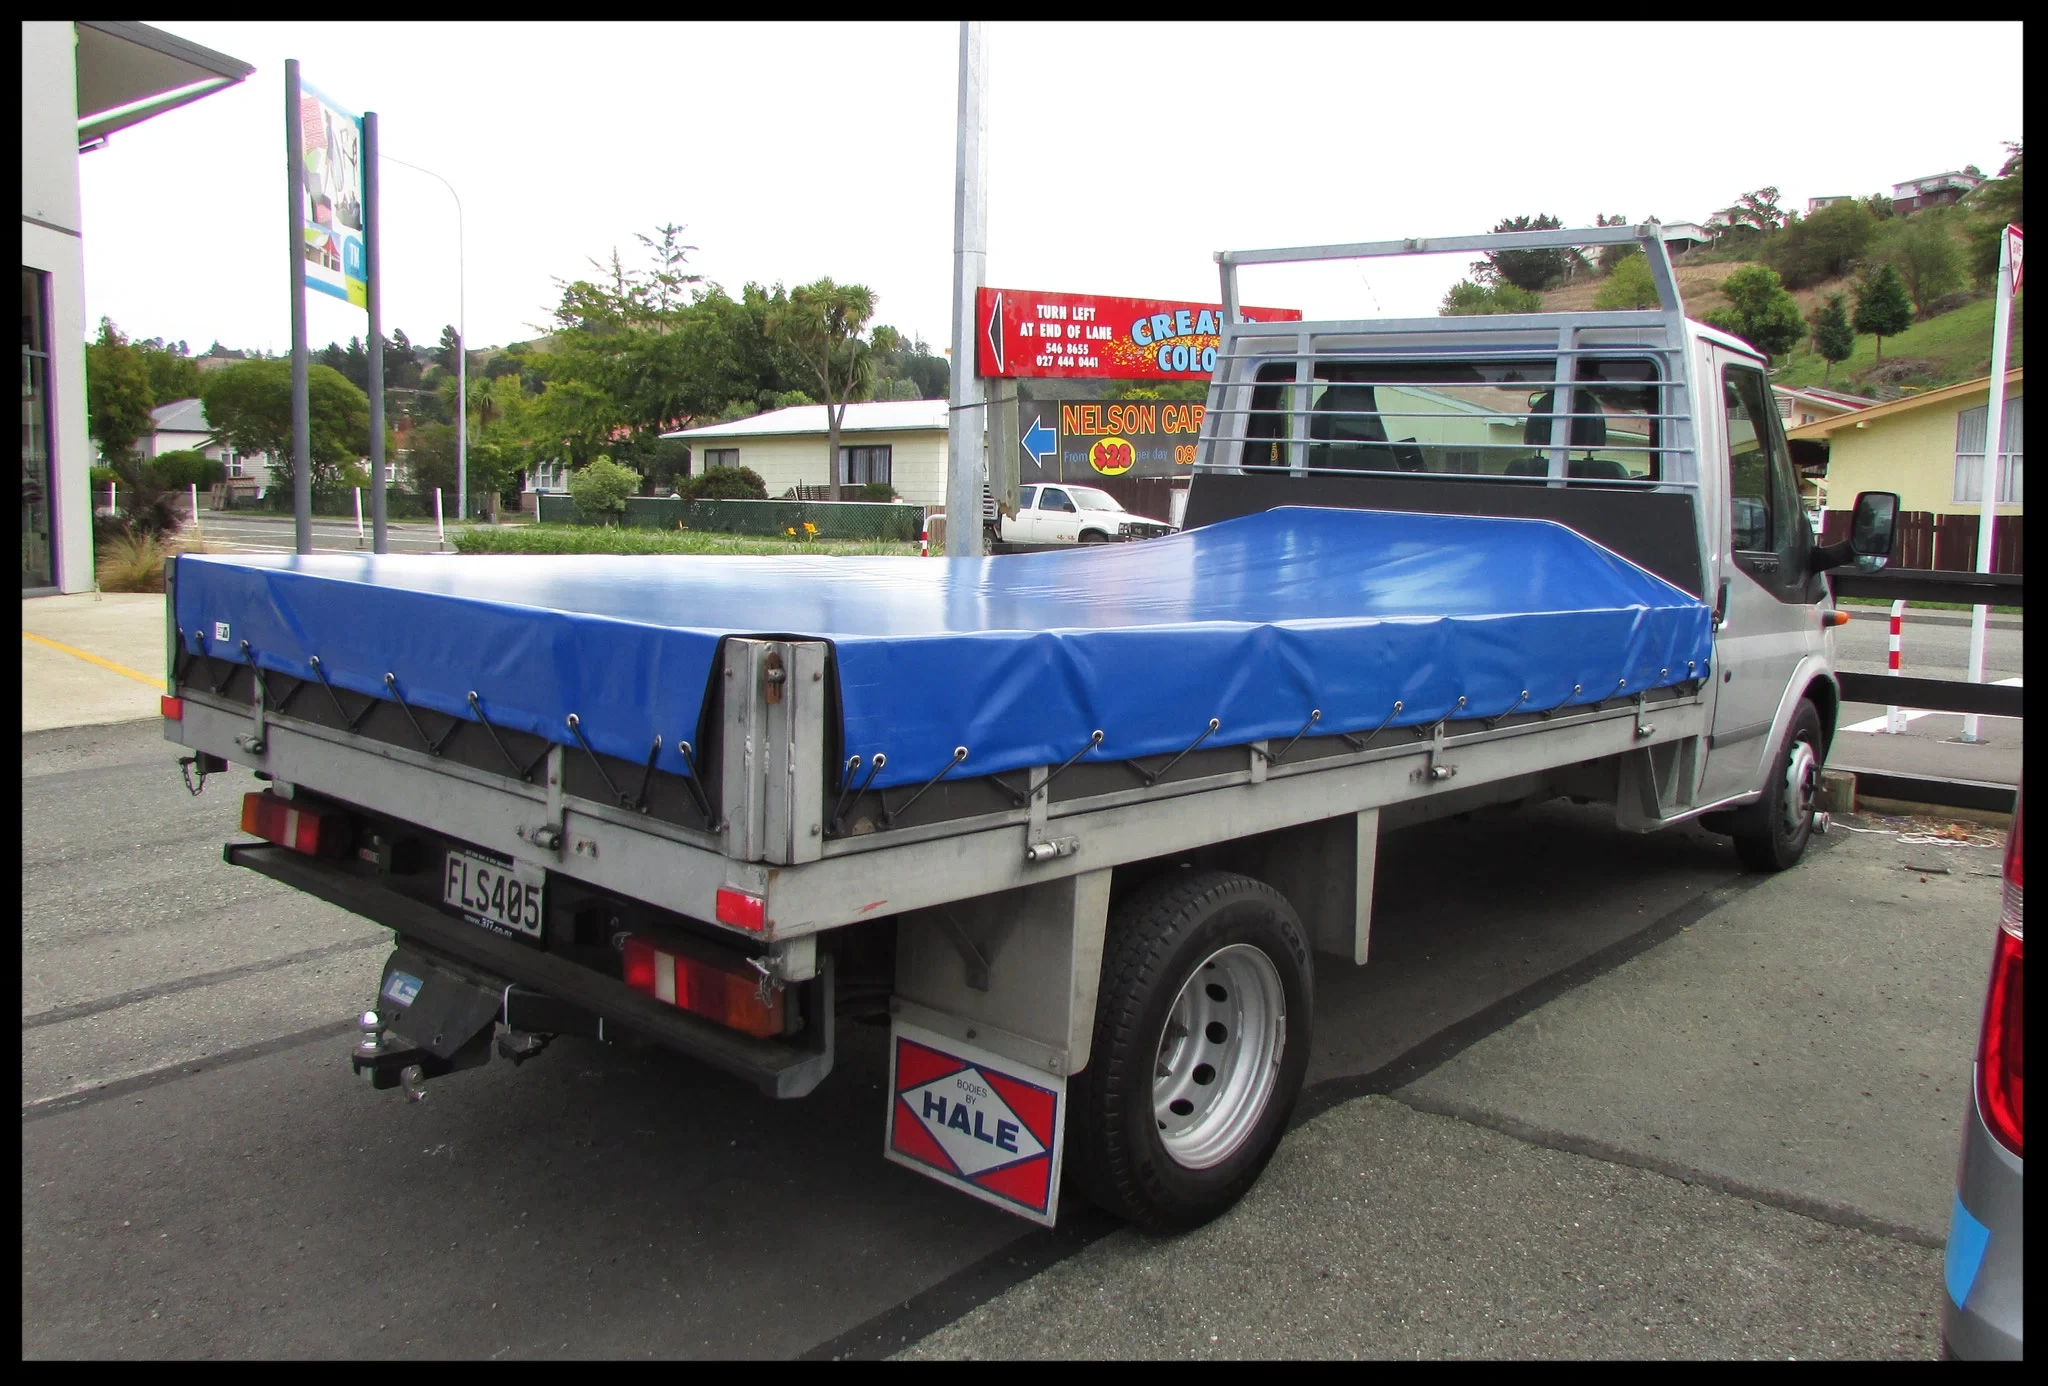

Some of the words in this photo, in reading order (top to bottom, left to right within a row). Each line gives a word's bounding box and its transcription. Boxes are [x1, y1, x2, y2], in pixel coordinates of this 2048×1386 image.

[1036, 304, 1067, 320] TURN
[1072, 306, 1096, 321] LEFT
[1020, 322, 1035, 337] AT
[1040, 323, 1062, 338] END
[1067, 324, 1081, 339] OF
[1086, 325, 1112, 340] LANE
[1045, 342, 1063, 354] 546
[1066, 343, 1089, 355] 8655
[1157, 345, 1218, 372] COLO
[1036, 355, 1054, 367] 027
[1057, 356, 1075, 367] 444
[1078, 357, 1099, 368] 0441
[1062, 404, 1156, 436] NELSON
[1064, 451, 1088, 463] From
[1093, 442, 1133, 471] $28
[1137, 450, 1150, 462] per
[1152, 448, 1168, 461] day
[447, 857, 540, 931] FLS405
[956, 1078, 988, 1098] BODIES
[965, 1094, 977, 1105] BY
[922, 1090, 1020, 1154] HALE
